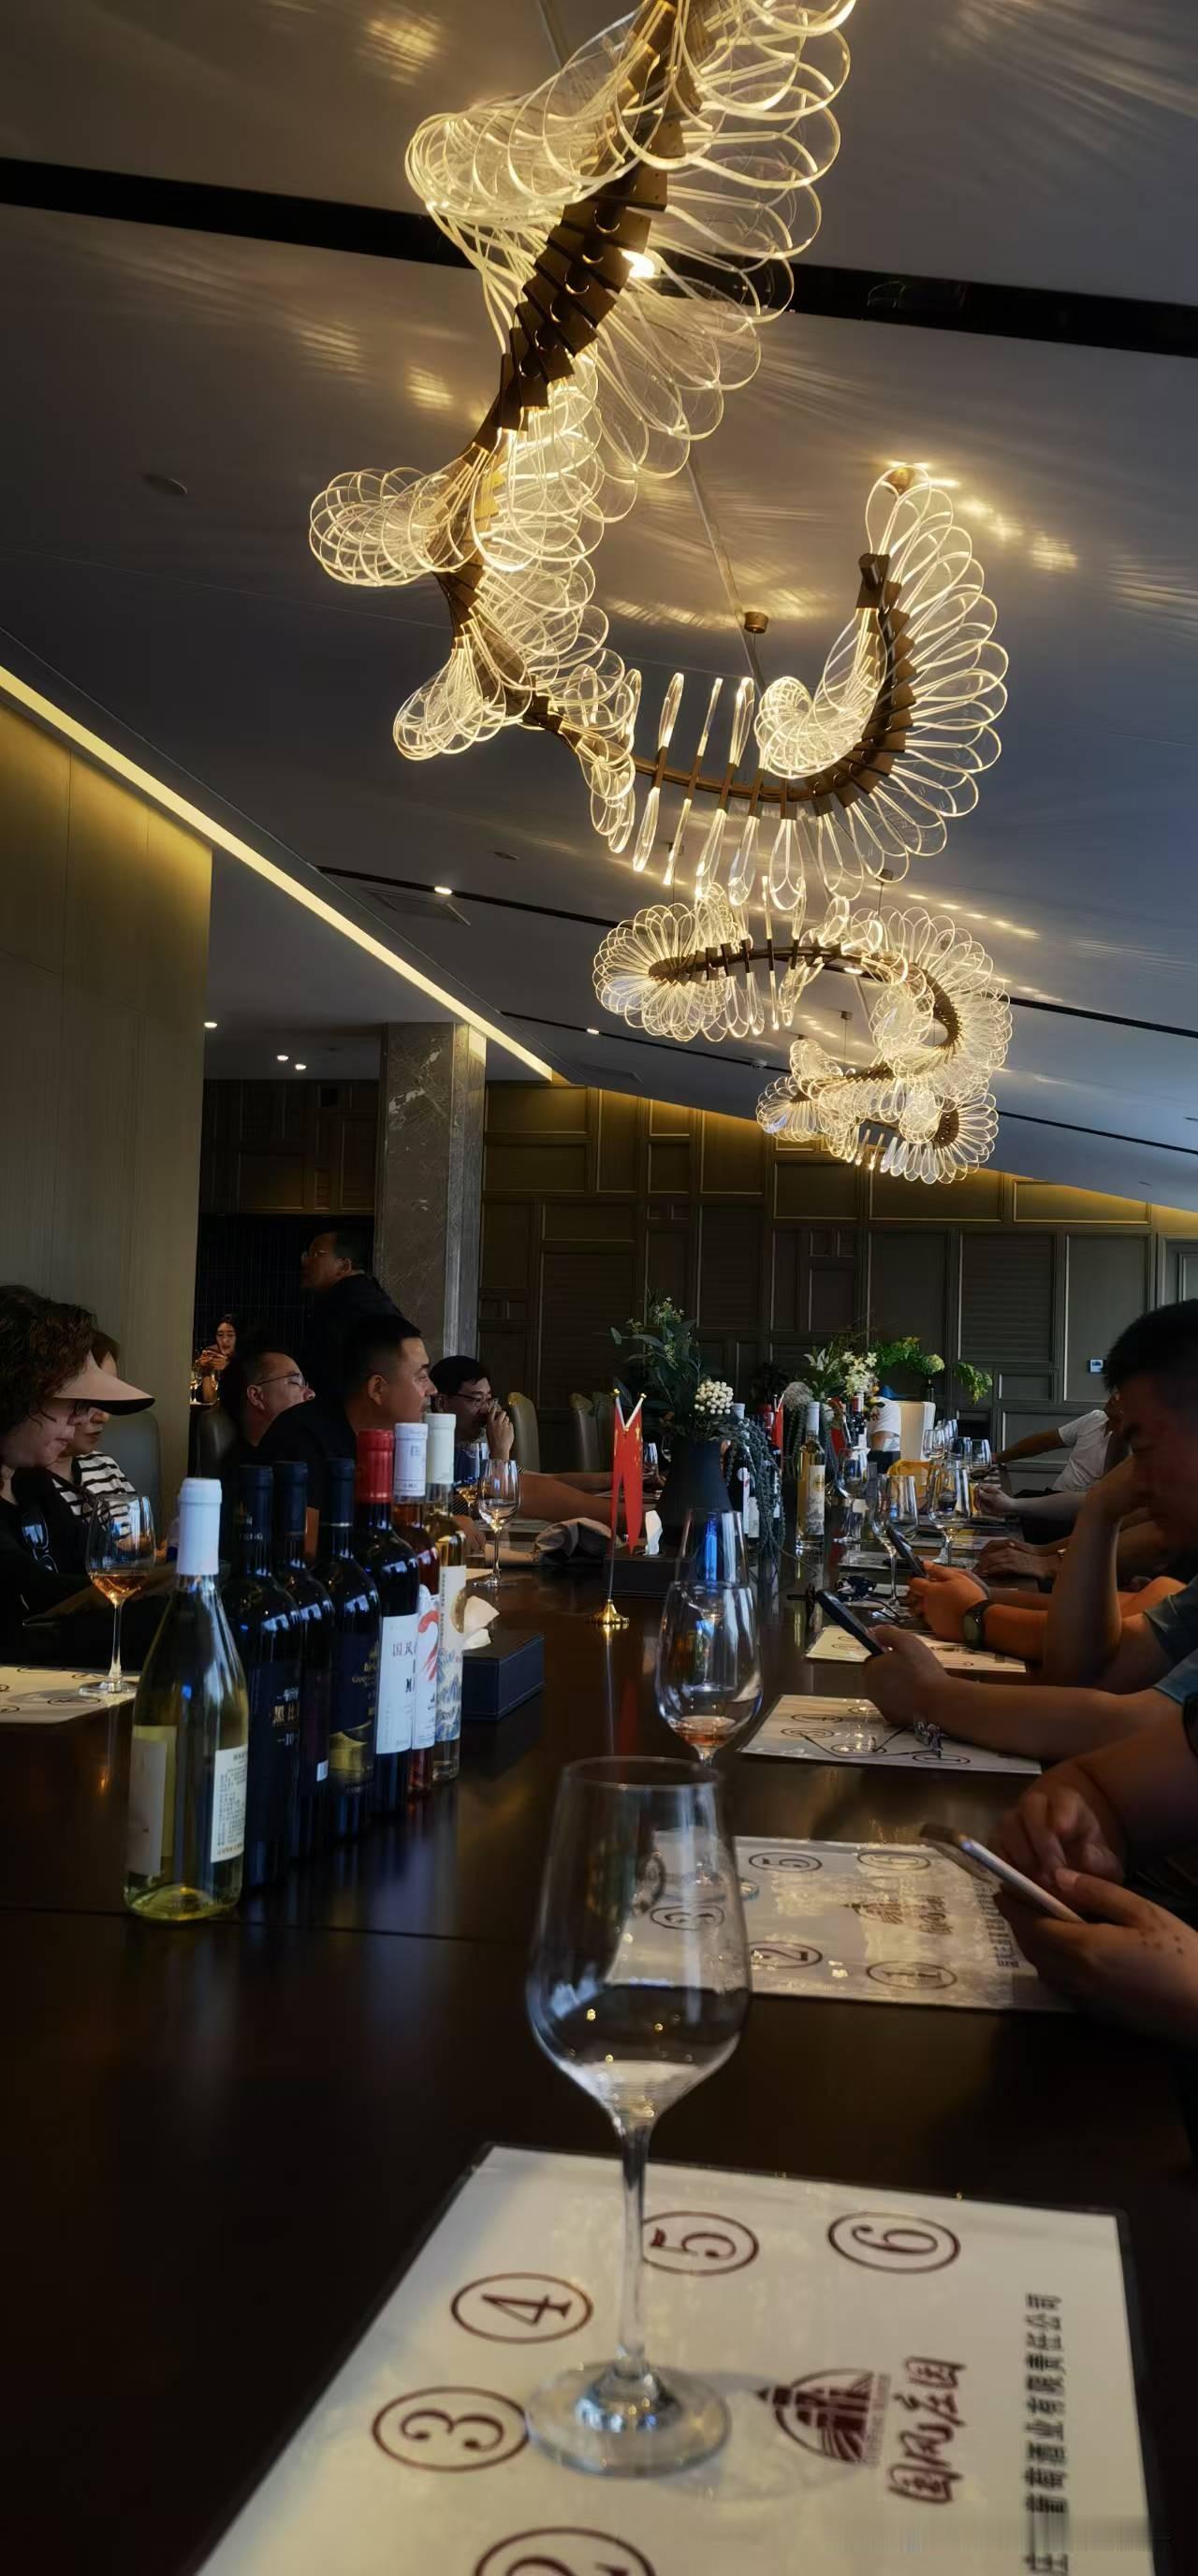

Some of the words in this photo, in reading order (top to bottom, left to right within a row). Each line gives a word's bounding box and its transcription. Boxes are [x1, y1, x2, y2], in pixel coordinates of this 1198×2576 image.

[888, 2355, 966, 2504] 国风庄园
[1023, 2293, 1070, 2576] 庄葡萄酒业有限责任公司
